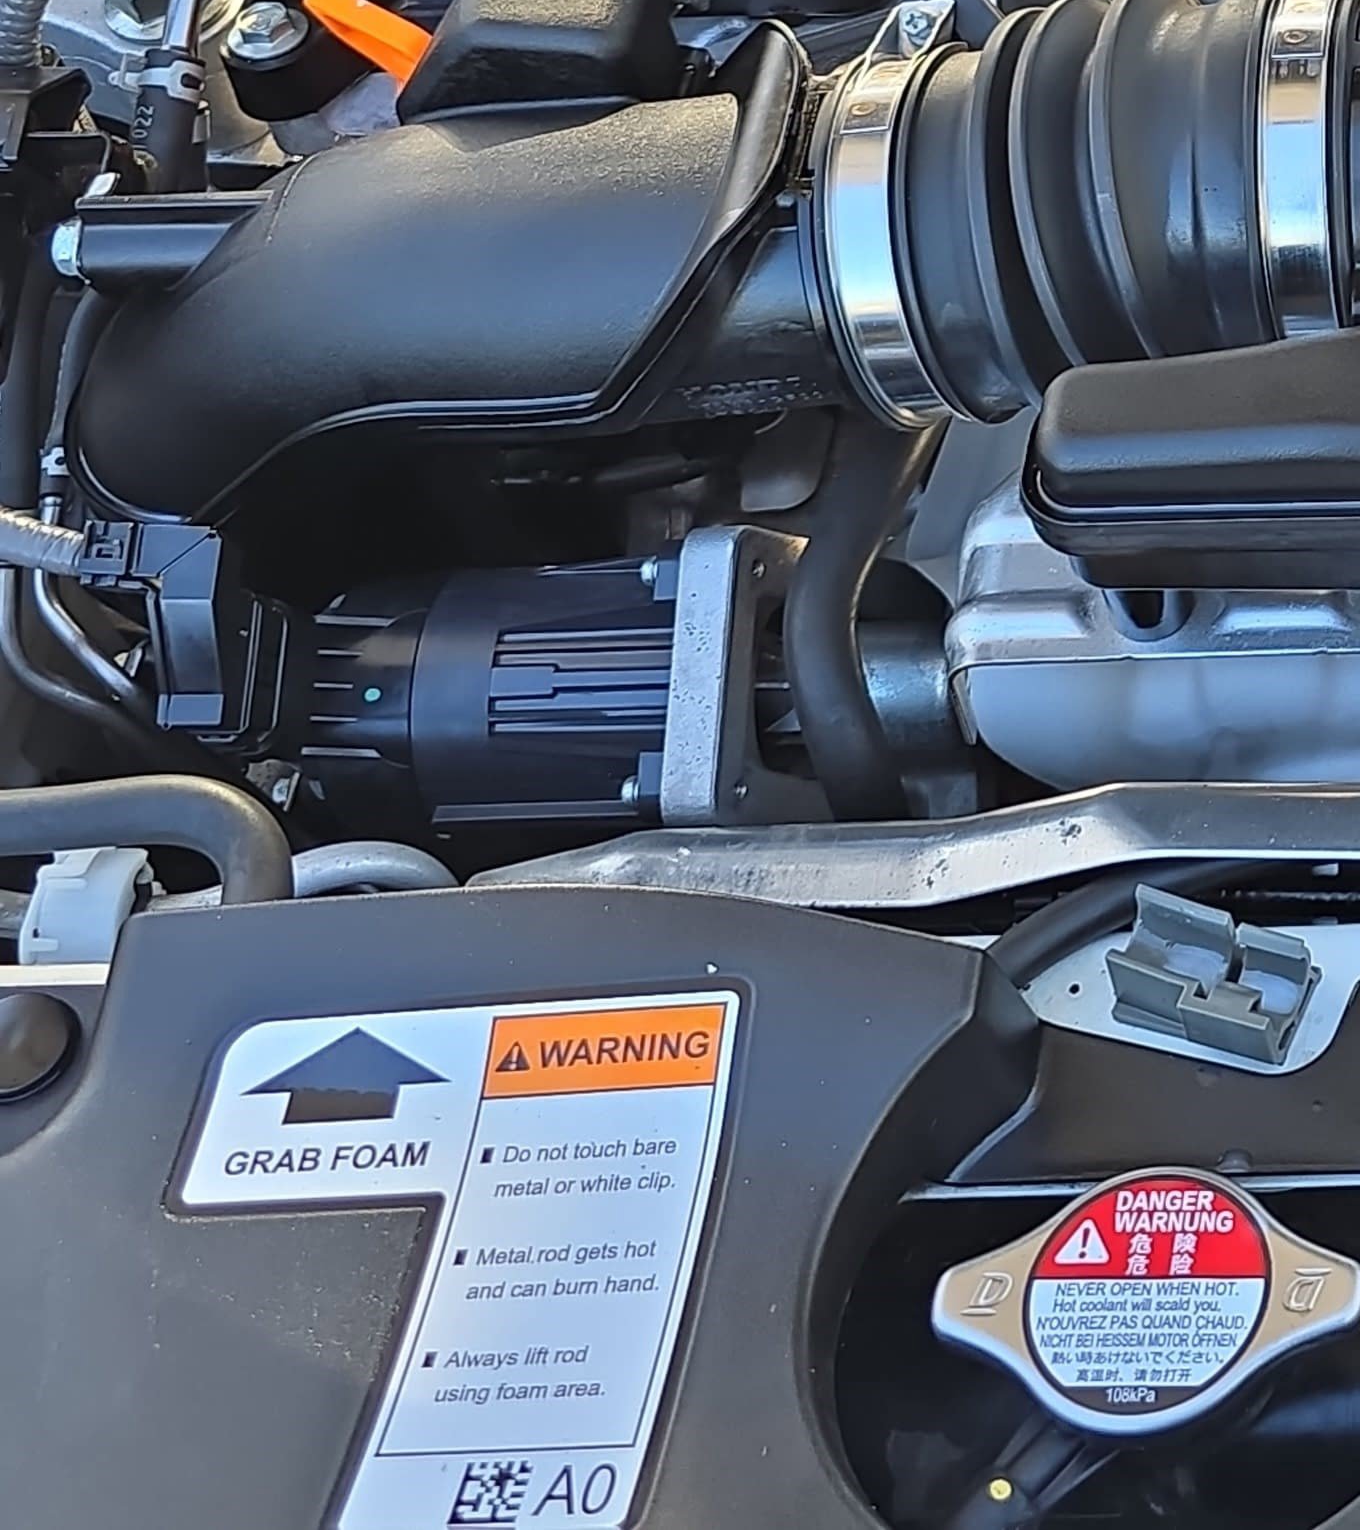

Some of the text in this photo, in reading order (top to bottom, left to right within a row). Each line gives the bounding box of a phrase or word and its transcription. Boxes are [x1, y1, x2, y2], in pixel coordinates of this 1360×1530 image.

[539, 1031, 711, 1069] WARNING
[224, 1141, 431, 1176] GRAB FOAM
[502, 1138, 677, 1163] Do not touch bare
[494, 1172, 676, 1198] metal or white clip.
[1116, 1190, 1215, 1211] DANGER
[1113, 1211, 1234, 1233] WARNUNG
[536, 1244, 571, 1263] rod
[574, 1242, 618, 1265] gets
[623, 1240, 657, 1259] hot
[466, 1274, 660, 1300] and can burn hand.
[1055, 1282, 1239, 1296] NEVER OPEN WHEN HOT.
[1052, 1299, 1077, 1312] Hot
[1079, 1297, 1128, 1311] coolant
[1131, 1298, 1153, 1311] will
[1155, 1297, 1191, 1311] scald
[1109, 1315, 1138, 1329] PAS
[1141, 1315, 1192, 1329] QUAND
[1075, 1333, 1095, 1347] BEI
[1096, 1333, 1146, 1347] HEISSEM
[1148, 1332, 1190, 1347] MOTOR
[444, 1345, 589, 1371] Always lift rod
[434, 1382, 605, 1405] using foam area.
[1105, 1387, 1157, 1403] 108kPa
[530, 1463, 618, 1516] A0
